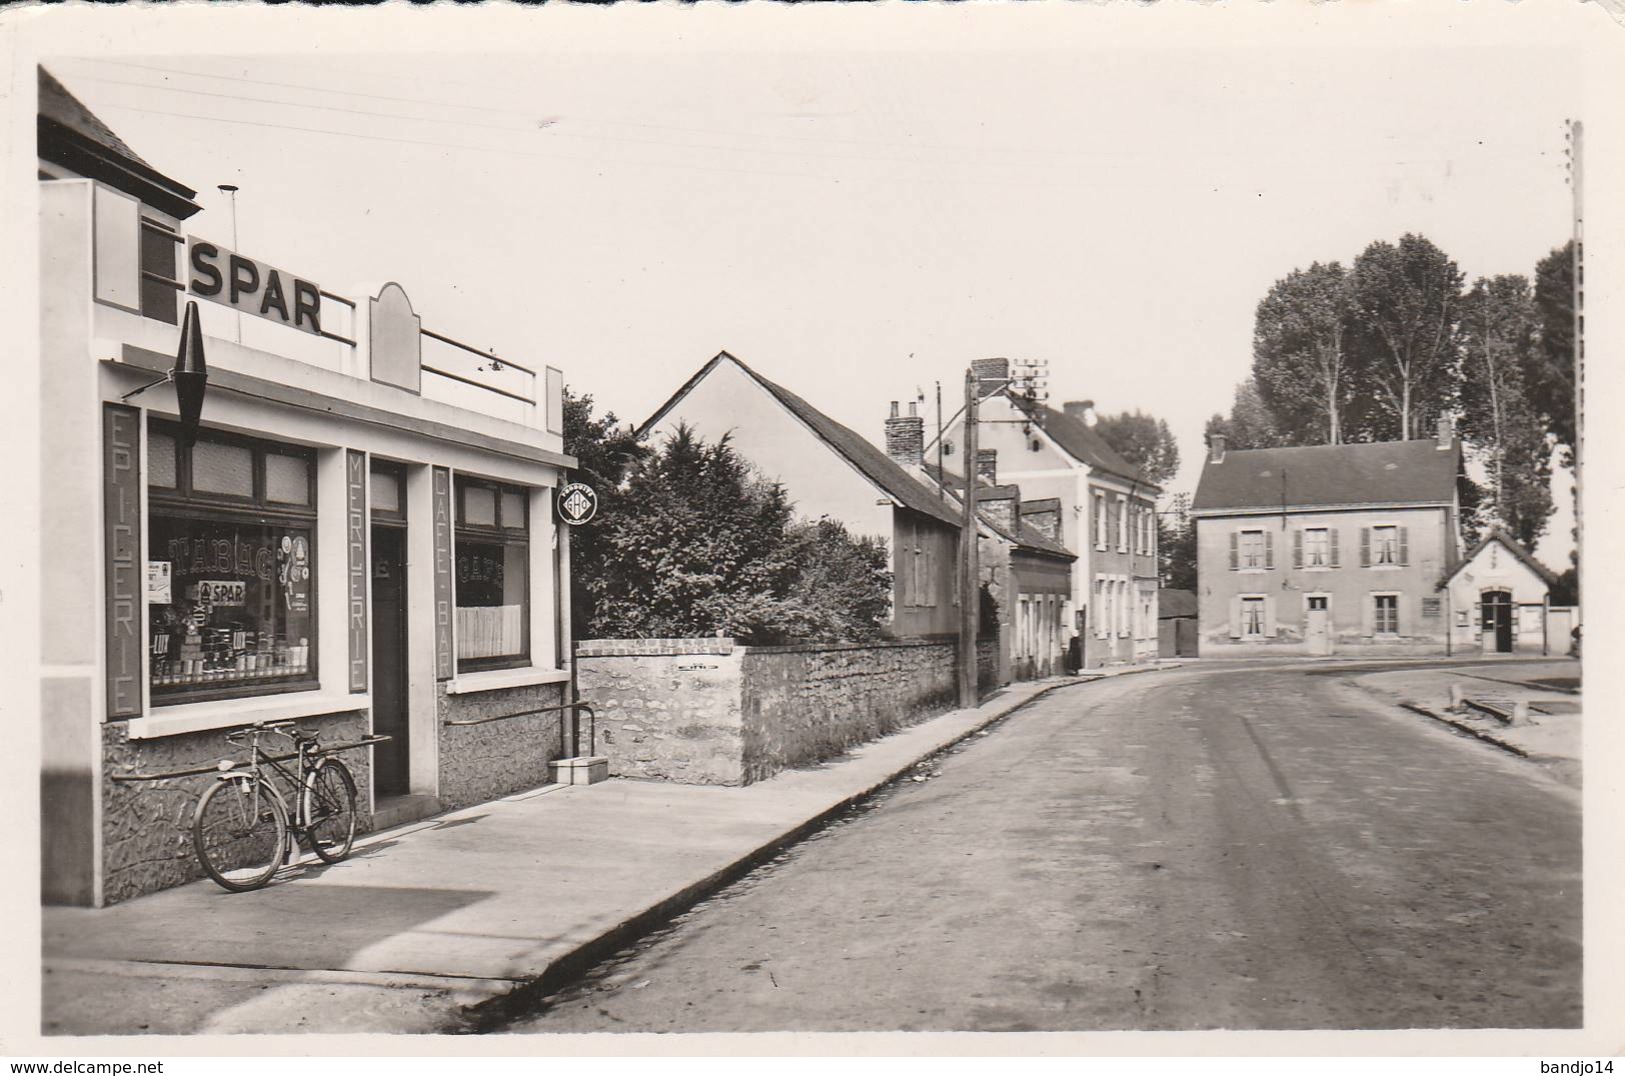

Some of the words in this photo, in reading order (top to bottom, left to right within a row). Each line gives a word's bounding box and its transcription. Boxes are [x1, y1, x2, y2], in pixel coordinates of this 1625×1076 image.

[191, 242, 321, 332] SPAR
[111, 410, 134, 714] EPICERIE
[168, 536, 273, 582] TABAC
[350, 455, 364, 688] MERCERIE
[213, 585, 243, 602] SPAR
[154, 634, 170, 654] LUX
